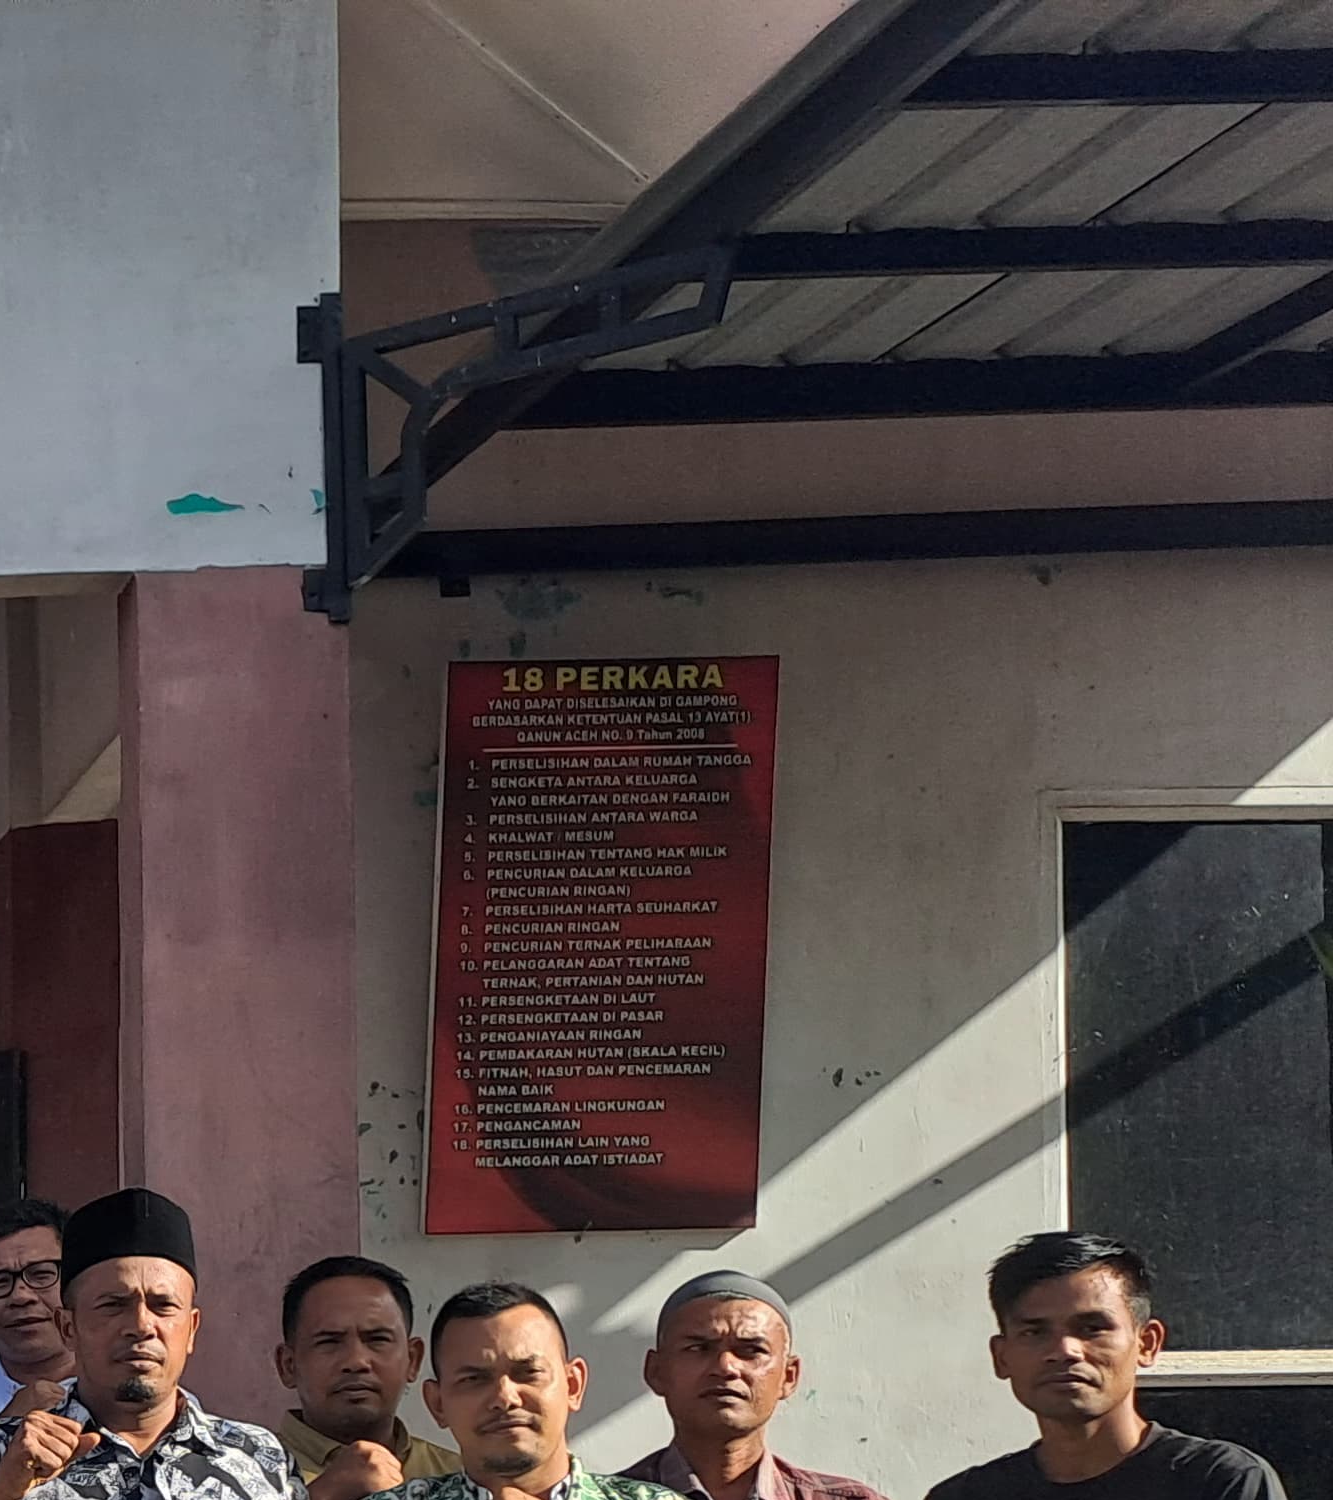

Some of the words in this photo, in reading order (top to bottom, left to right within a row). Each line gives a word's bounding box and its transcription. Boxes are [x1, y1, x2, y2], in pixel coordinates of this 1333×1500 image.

[502, 667, 544, 692] 18
[556, 664, 724, 691] PERKARA
[487, 699, 520, 710] YANG
[525, 698, 563, 710] DAPAT
[567, 696, 655, 709] DISELESAIKAN
[659, 696, 672, 706] DI
[675, 695, 737, 706] GAMPONG
[473, 714, 563, 727] BERDASARKAN
[567, 714, 641, 726] KETENTUAN
[645, 712, 683, 724] PASAL
[565, 730, 598, 742] ACEH
[637, 729, 673, 741] Tahun
[469, 760, 480, 770] 1.
[491, 758, 589, 770] PERSELISIHAN
[593, 757, 639, 768] DALAM
[643, 756, 693, 767] RUMAH
[697, 755, 751, 766] TANGGA
[467, 779, 479, 789] 2.
[491, 777, 563, 789] SENGKETA
[567, 775, 621, 787] ANTARA
[625, 774, 697, 786] KELUARGA
[490, 796, 527, 807] YANG
[531, 794, 608, 806] BERKAITAN
[613, 792, 669, 804] DENGAN
[465, 815, 477, 825] 3.
[489, 813, 587, 826] PERSELISIHAN
[591, 812, 645, 823] ANTARA
[649, 811, 698, 822] WARGA
[464, 834, 476, 844] 4.
[489, 832, 553, 843] KHALWAT
[565, 830, 614, 842] MESUM
[487, 850, 585, 862] PERSELISIHAN
[589, 848, 653, 860] TENTANG
[657, 847, 685, 858] HAK
[689, 846, 728, 857] MILIK
[487, 868, 565, 880] PENCURIAN
[569, 867, 616, 878] DALAM
[619, 865, 693, 877] KELUARGA
[486, 886, 569, 900] (PENCURIAN
[573, 885, 631, 898] RINGAN)
[462, 906, 473, 917] 7.
[485, 904, 583, 916] PERSELISIHAN
[587, 902, 632, 914] HARTA
[485, 923, 563, 934] PENCURIAN
[567, 922, 620, 933] RINGAN
[484, 941, 563, 953] PENCURIAN
[567, 940, 621, 950] TERNAK
[626, 938, 712, 949] PELIHARAAN
[460, 961, 479, 972] 10.
[483, 958, 583, 971] PELANGGARAN
[588, 957, 623, 968] ADAT
[627, 956, 691, 967] TENTANG
[483, 977, 541, 989] TERNAK,
[546, 975, 622, 987] PERTANIAN
[627, 974, 654, 986] DAN
[658, 973, 704, 984] HUTAN
[458, 997, 477, 1008] 11.
[481, 994, 599, 1007] PERSENGKETAAN
[603, 994, 617, 1004] DI
[621, 993, 656, 1004] LAUT
[458, 1015, 477, 1026] 12.
[481, 1012, 598, 1025] PERSENGKETAAN
[603, 1012, 616, 1022] DI
[620, 1011, 663, 1022] PASAR
[457, 1033, 476, 1043] 13.
[480, 1030, 585, 1042] PENGANIAYAAN
[589, 1029, 642, 1040] RINGAN
[456, 1052, 475, 1062] 14.
[479, 1049, 573, 1061] PEMBAKARAN
[577, 1048, 623, 1059] HUTAN
[628, 1047, 677, 1060] (SKALA
[681, 1045, 726, 1057] KECIL)
[537, 1066, 582, 1077] HASUT
[587, 1065, 614, 1076] DAN
[618, 1063, 711, 1075] PENCEMARAN
[478, 1084, 518, 1097] NAMA
[521, 1084, 553, 1096] BAIK
[477, 1102, 571, 1114] PENCEMARAN
[575, 1100, 665, 1112] LINGKUNGAN
[453, 1122, 472, 1133] 17.
[476, 1120, 581, 1132] PENGANCAMAN
[452, 1140, 471, 1150] 18.
[476, 1137, 575, 1150] PERSELISIHAN
[578, 1136, 609, 1148] LAIN
[613, 1136, 650, 1147] YANG
[475, 1155, 560, 1168] MELANGGAR
[564, 1154, 597, 1166] ADAT
[602, 1153, 664, 1165] ISTIADAT
